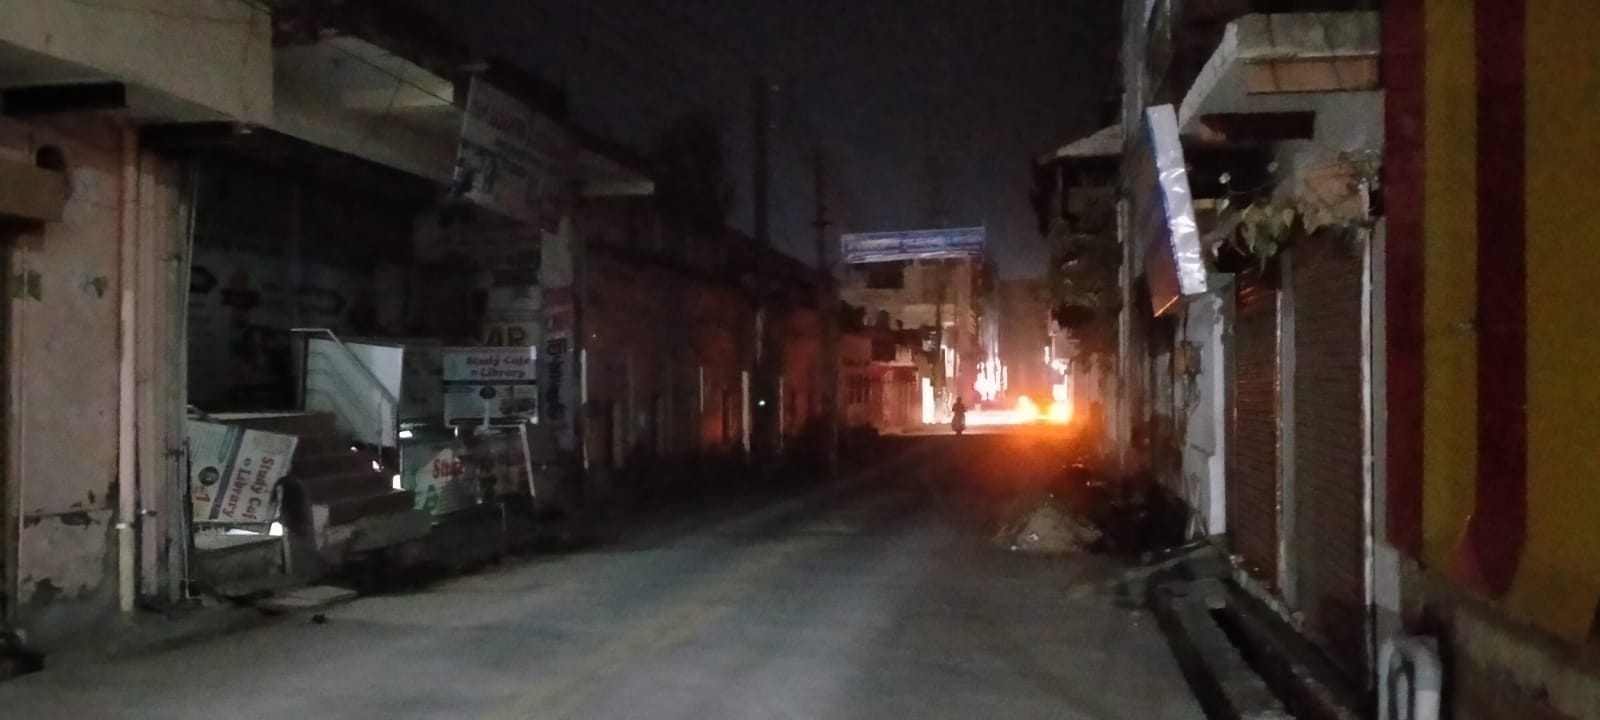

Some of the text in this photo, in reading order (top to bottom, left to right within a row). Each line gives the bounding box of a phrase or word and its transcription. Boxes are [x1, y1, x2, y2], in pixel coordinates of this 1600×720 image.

[481, 367, 525, 378] Library
[222, 469, 251, 517] Library
[242, 457, 274, 519] Study Caf
